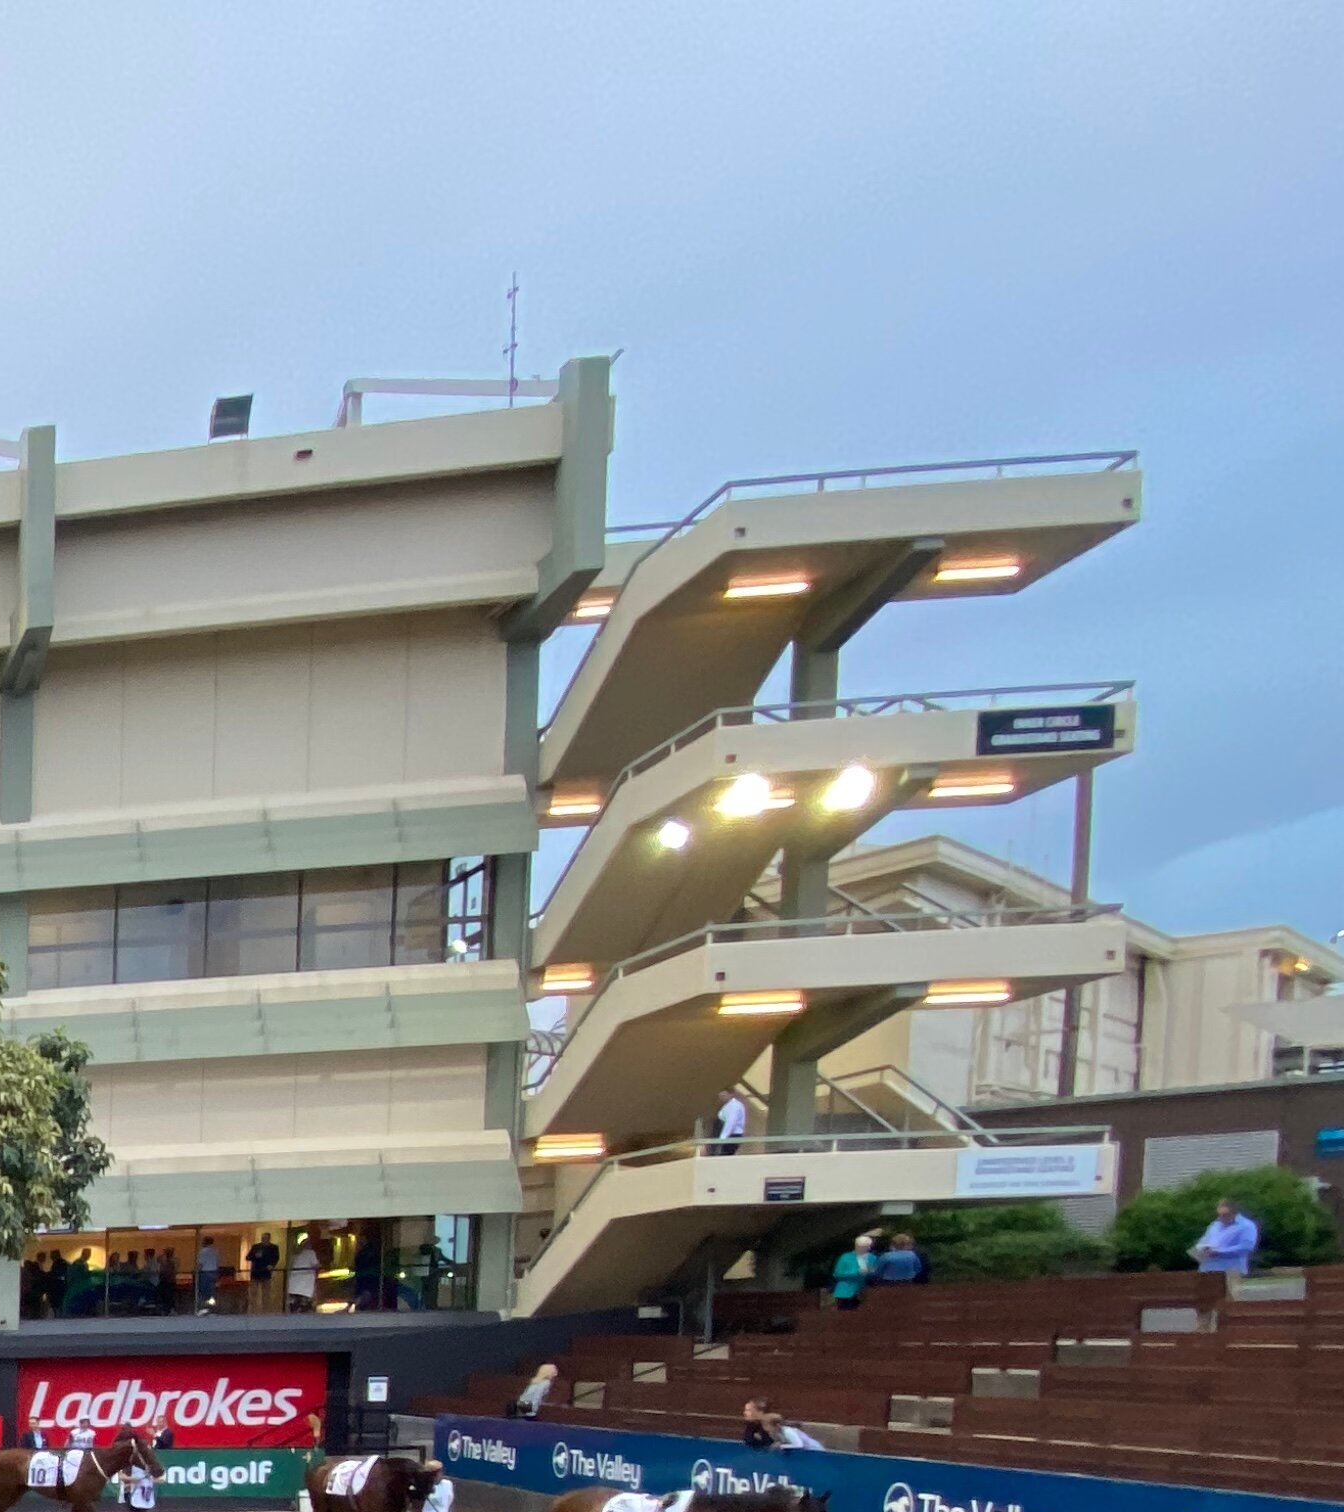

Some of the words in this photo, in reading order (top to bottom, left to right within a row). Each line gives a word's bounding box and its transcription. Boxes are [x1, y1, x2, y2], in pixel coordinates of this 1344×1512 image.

[28, 1378, 302, 1428] Ladbrokes
[462, 1436, 481, 1460] The
[482, 1438, 517, 1471] Valley
[569, 1449, 596, 1477] The
[596, 1451, 641, 1490] Valley
[30, 1467, 46, 1484] 10
[210, 1460, 273, 1490] golf
[715, 1467, 750, 1495] The
